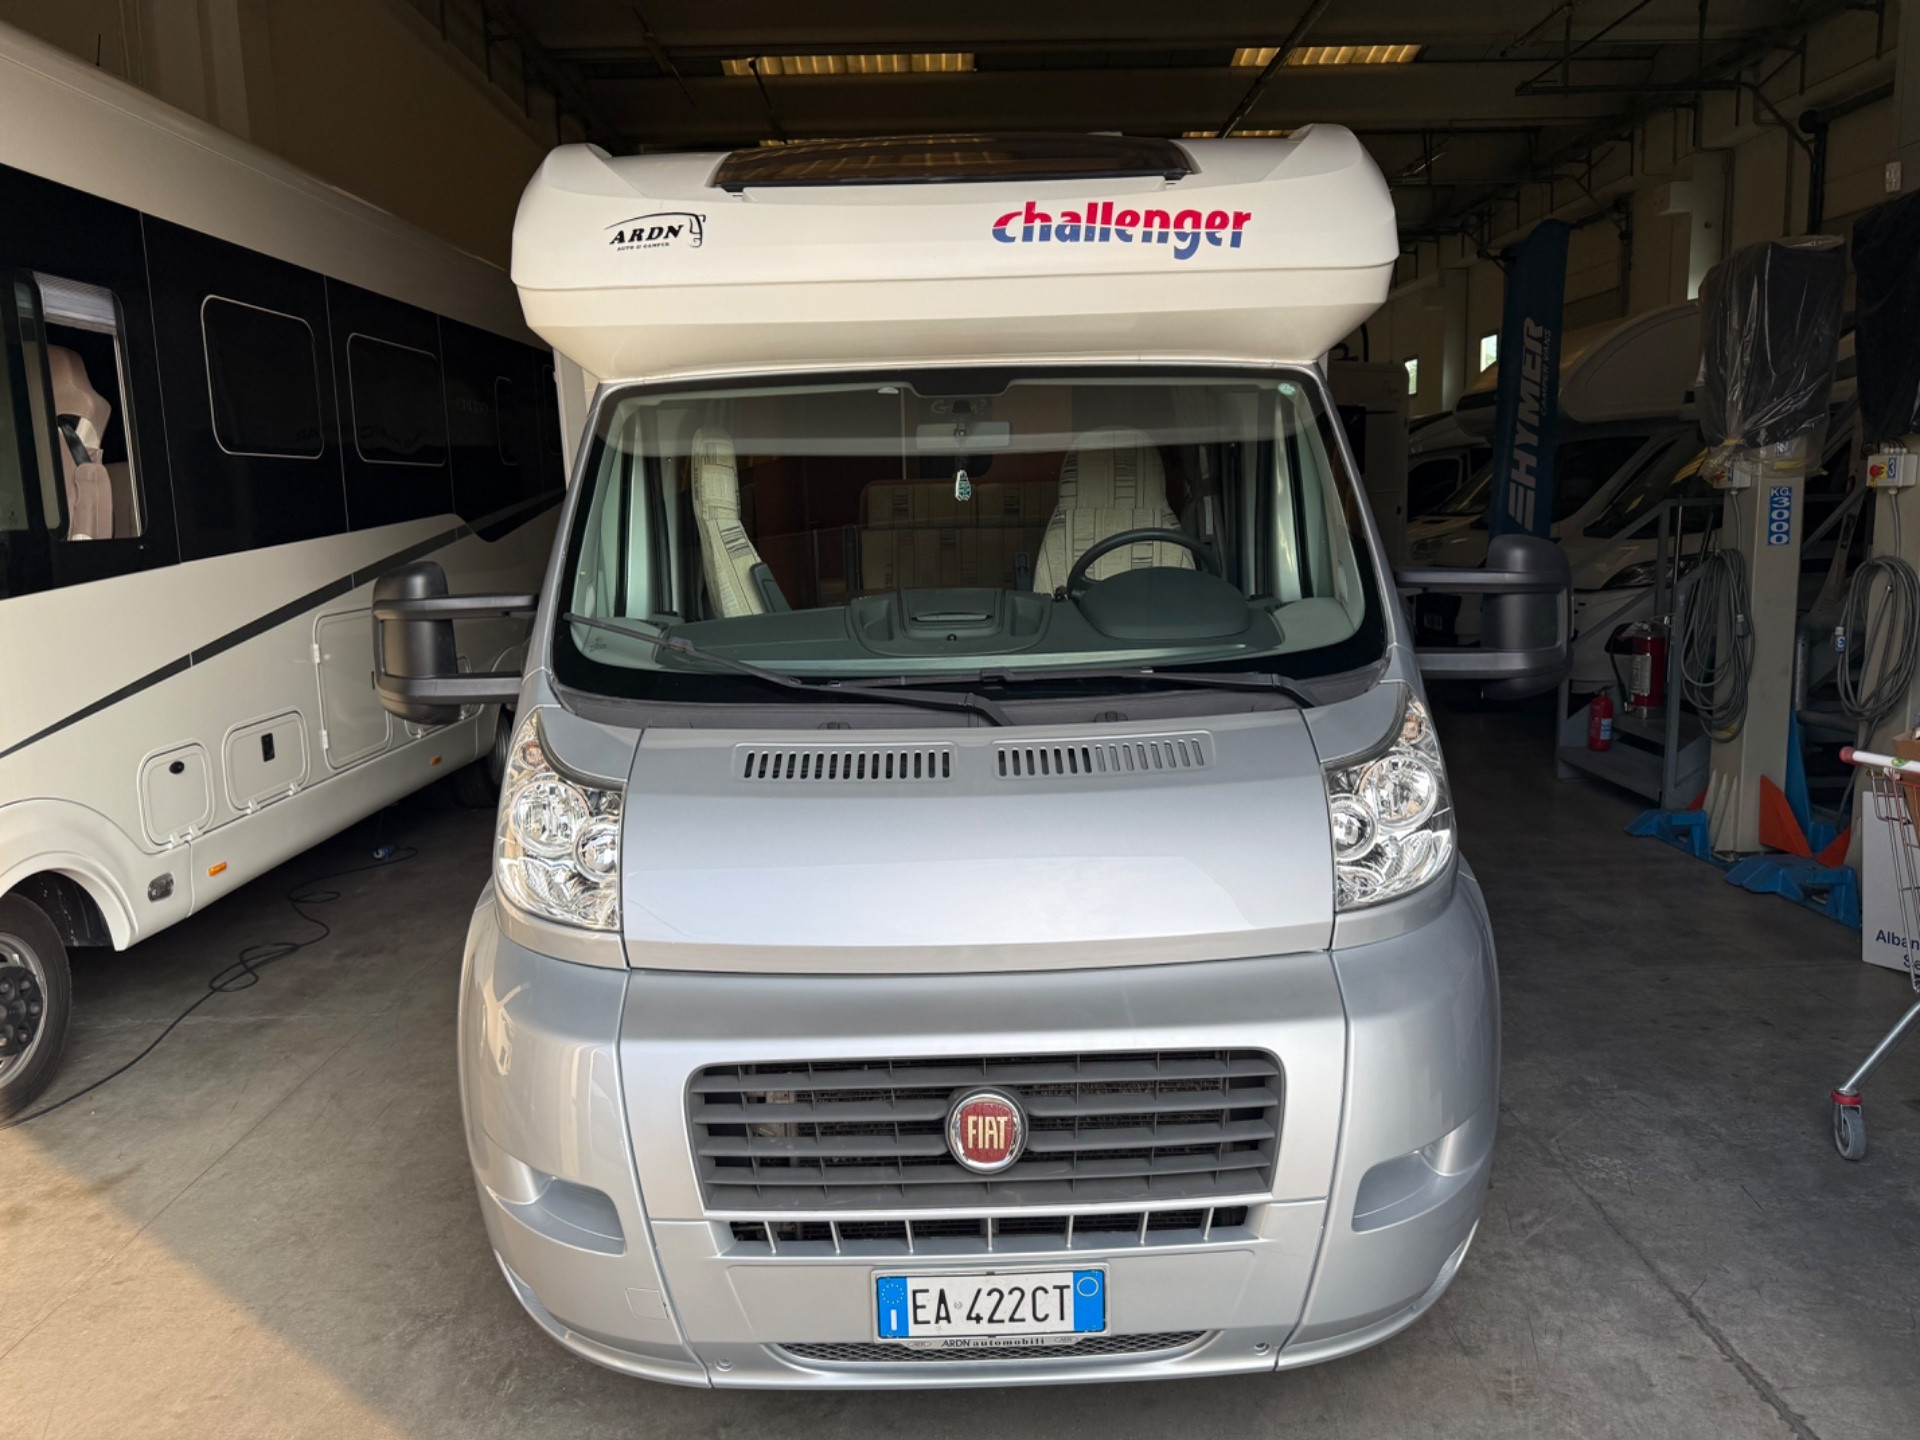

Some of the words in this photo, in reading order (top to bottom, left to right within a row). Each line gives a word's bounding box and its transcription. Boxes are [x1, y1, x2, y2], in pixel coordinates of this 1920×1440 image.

[609, 225, 684, 245] ARDN
[992, 201, 1252, 260] challenger
[1511, 317, 1544, 488] HYMER
[967, 1115, 1008, 1150] FIAT
[912, 1288, 952, 1325] EA
[966, 1284, 1071, 1324] 422CT
[942, 1339, 971, 1347] ARDN
